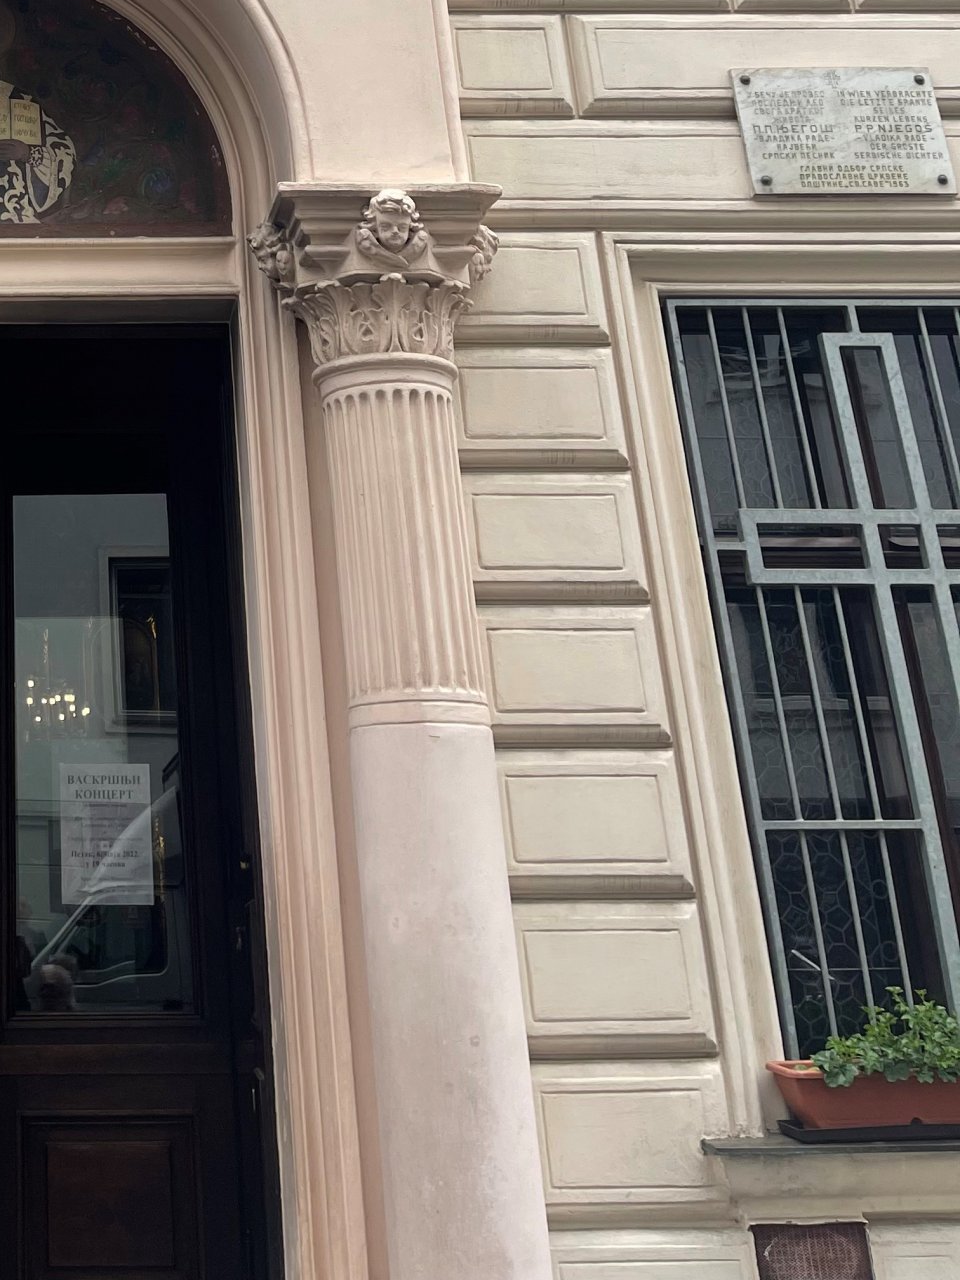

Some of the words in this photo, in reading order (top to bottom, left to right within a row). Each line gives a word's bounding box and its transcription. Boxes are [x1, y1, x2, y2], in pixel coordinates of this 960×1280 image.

[847, 90, 871, 98] WIEN
[873, 90, 933, 98] VERBRACHTE
[857, 98, 895, 106] LETZTE
[892, 115, 928, 123] LEBENS
[870, 143, 887, 151] DER
[761, 152, 797, 160] СРПСКИ
[800, 152, 836, 160] ПЕСНИК
[854, 151, 902, 160] SERBISCHE
[905, 151, 945, 160] DICHTER
[799, 165, 834, 173] ГЛАВНИ
[837, 165, 867, 173] ОДБОР
[869, 165, 905, 173] СРПСКЕ
[799, 172, 866, 180] ПРАВОСЛАВНЕ
[867, 172, 909, 181] ЦРКВЕНЕ
[67, 775, 141, 785] ВАСКРШЊИ
[75, 789, 134, 801] КОНЦЕРТ
